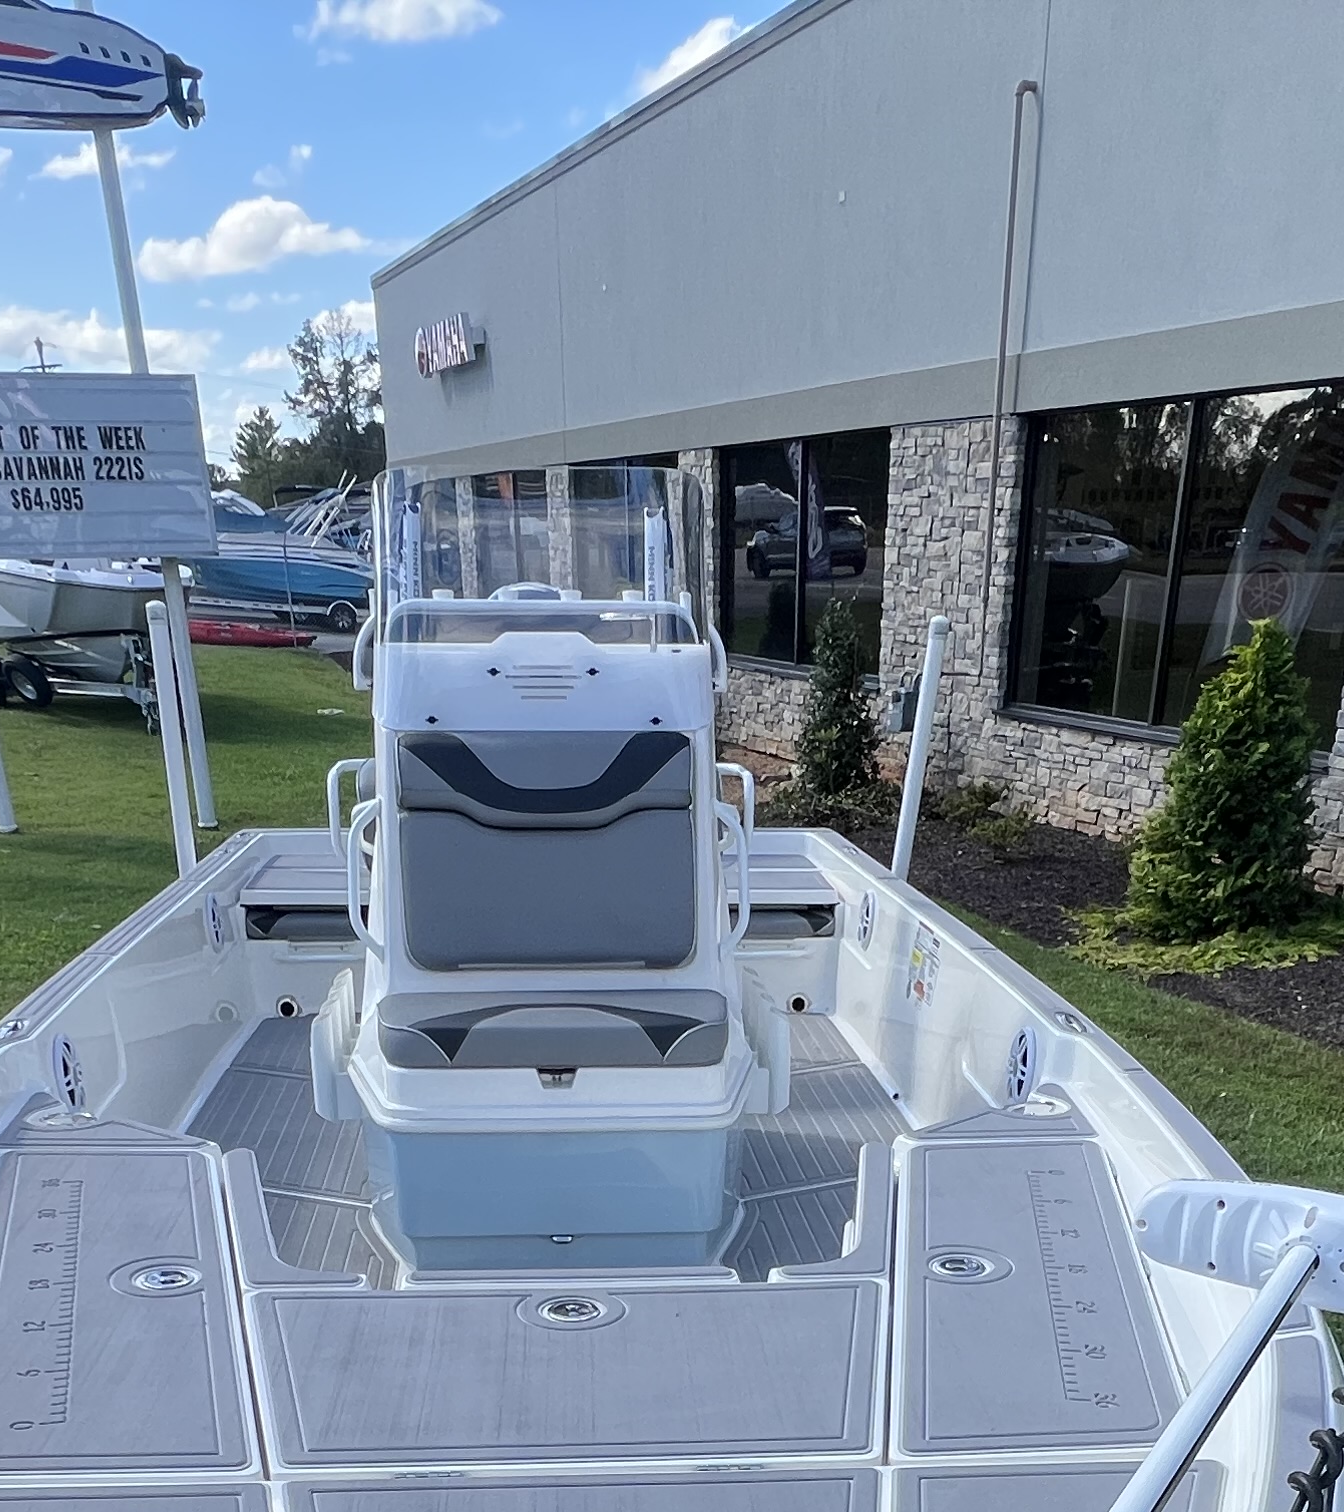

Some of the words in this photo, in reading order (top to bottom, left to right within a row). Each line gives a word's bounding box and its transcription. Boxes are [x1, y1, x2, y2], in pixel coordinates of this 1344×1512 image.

[19, 425, 40, 450] OF
[51, 425, 88, 450] THE
[97, 425, 147, 451] WEEK
[92, 456, 145, 481] 222IS
[10, 486, 84, 511] $64,995
[647, 545, 656, 582] MINN
[647, 584, 656, 601] KO
[37, 1208, 57, 1219] 30
[1060, 1228, 1080, 1238] 12
[32, 1241, 54, 1253] 24
[1067, 1263, 1088, 1274] 18
[27, 1278, 50, 1290] 18
[1075, 1300, 1098, 1313] 24
[22, 1320, 46, 1332] 12
[1084, 1343, 1107, 1359] 30
[16, 1369, 41, 1377] 6
[1094, 1392, 1120, 1408] 36
[9, 1421, 35, 1430] 0
